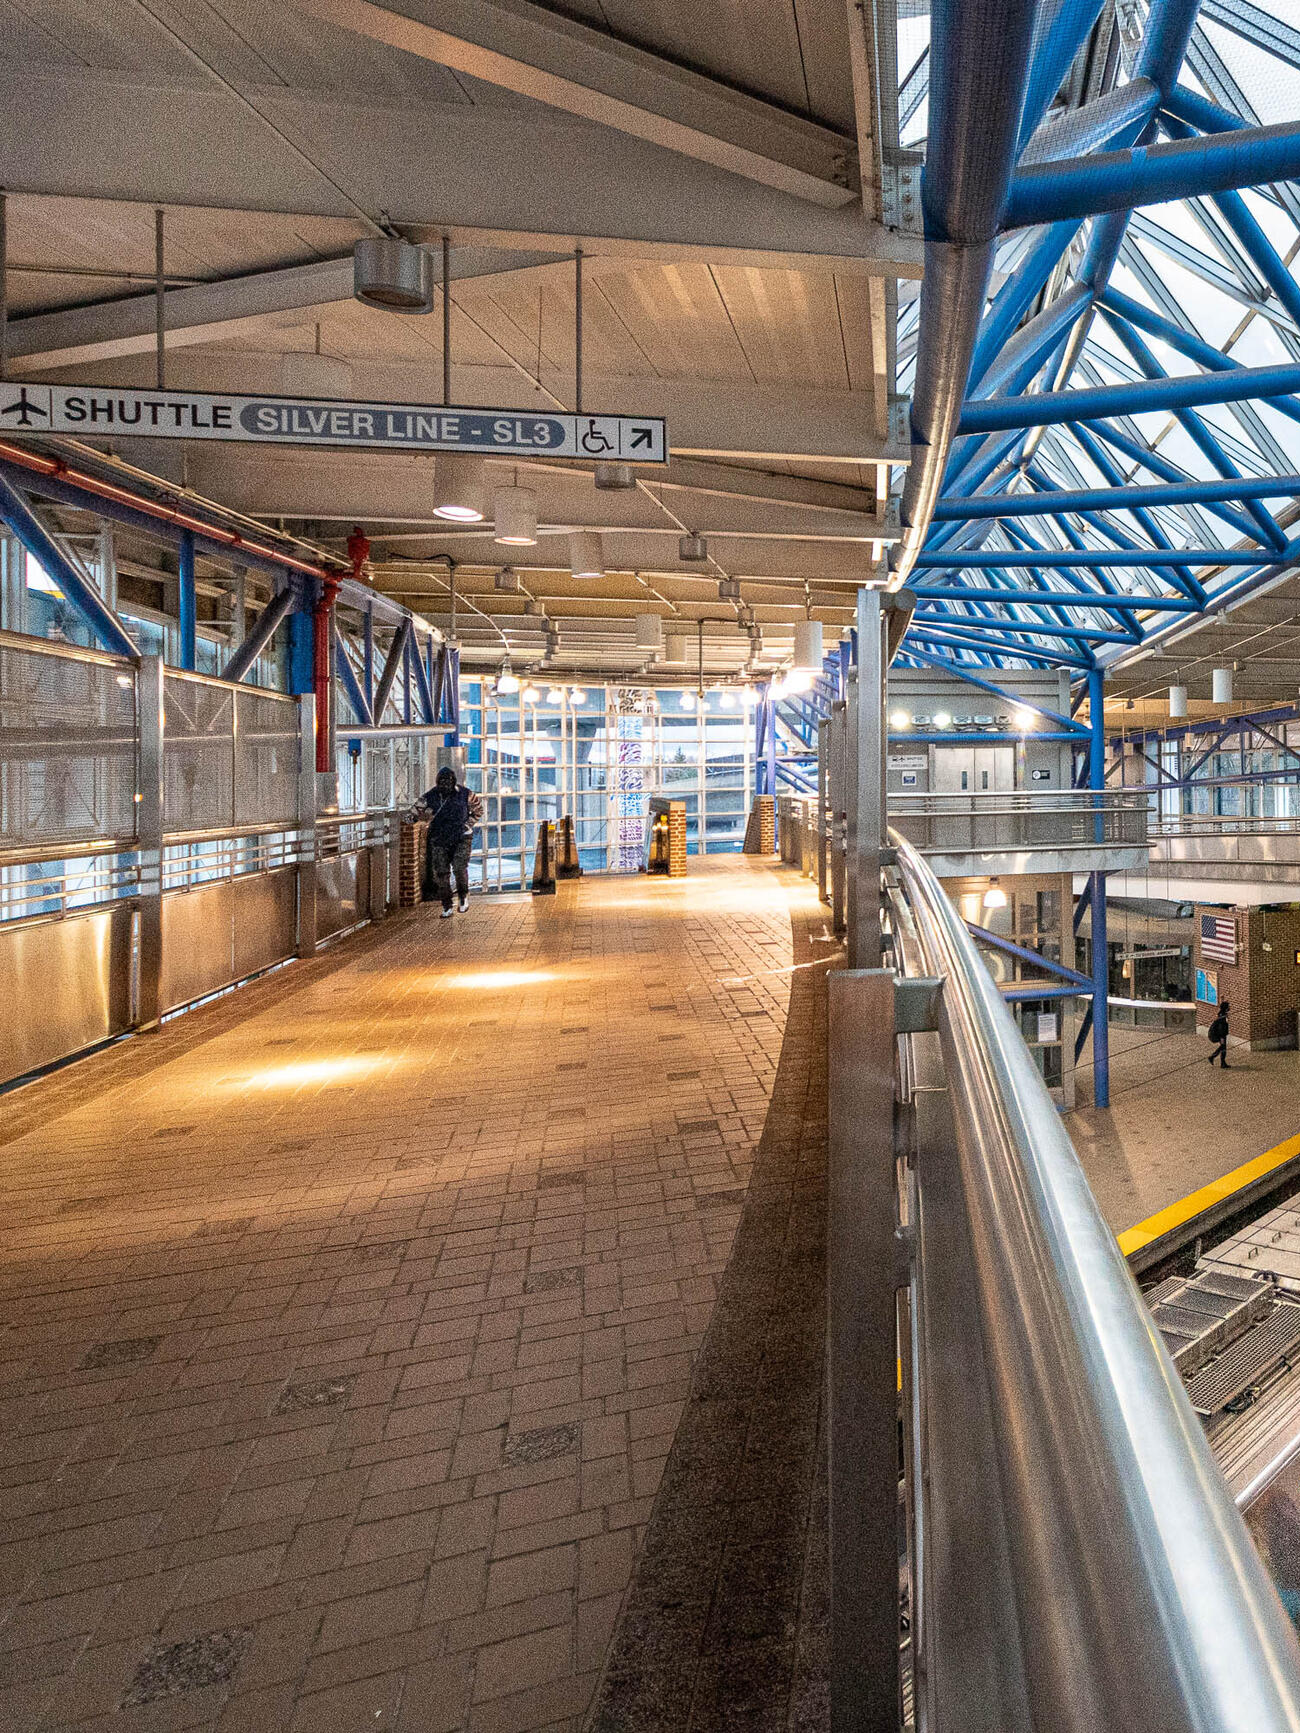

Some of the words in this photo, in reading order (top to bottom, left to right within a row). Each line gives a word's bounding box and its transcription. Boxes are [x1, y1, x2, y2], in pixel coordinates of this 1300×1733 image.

[64, 397, 232, 429] SHUTTLE
[256, 407, 374, 436] SILVER
[387, 414, 460, 441] LINE
[493, 420, 551, 445] SL3
